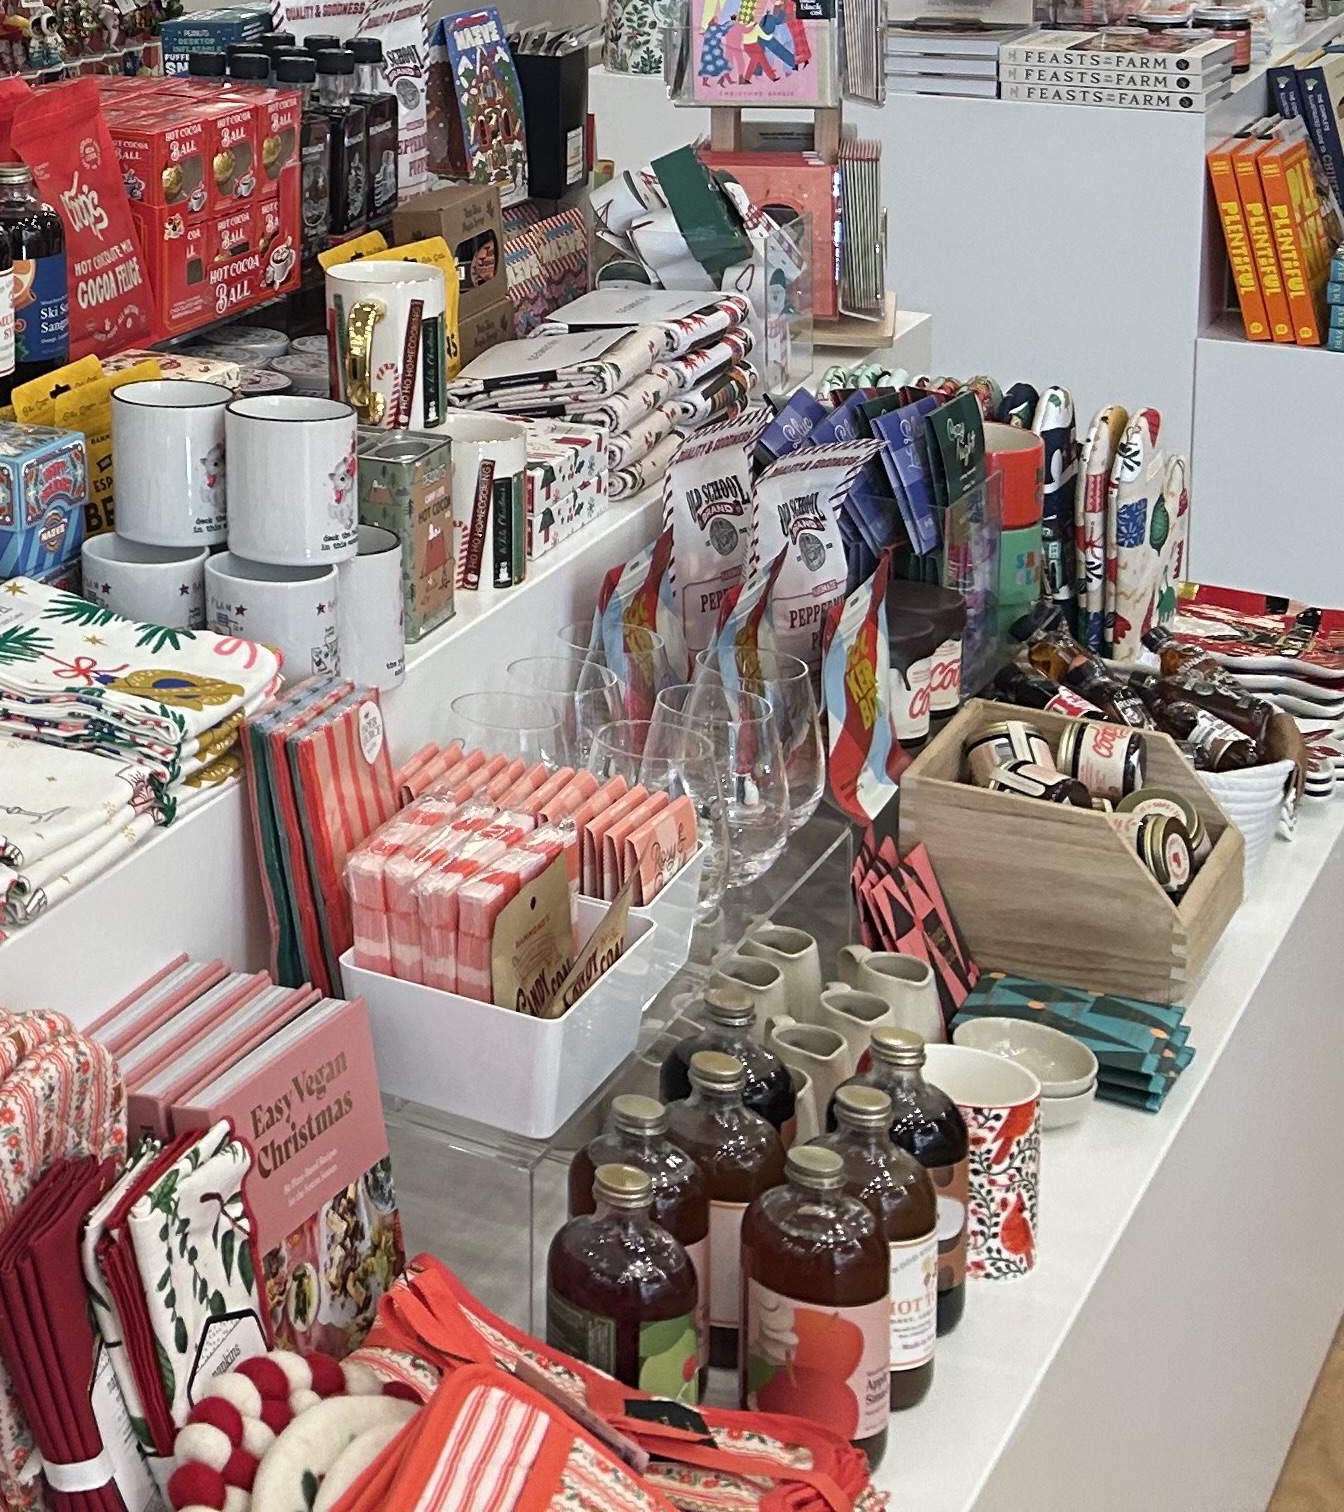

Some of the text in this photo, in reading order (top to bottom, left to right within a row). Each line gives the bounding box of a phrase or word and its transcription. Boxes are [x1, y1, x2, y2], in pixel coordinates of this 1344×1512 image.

[323, 2, 366, 18] GOODNESS
[1024, 51, 1168, 71] FEASTS FARM
[1024, 69, 1168, 89] FEASTS FARM
[1026, 87, 1171, 107] FEASTS FARM
[217, 111, 251, 129] HOT COCOA
[271, 112, 292, 132] BALL
[165, 124, 201, 143] HOT COCOA
[220, 127, 246, 148] BALL
[170, 141, 196, 162] BALL
[217, 212, 250, 232] HOT COCOA
[221, 228, 244, 250] BALL
[1221, 201, 1256, 296] PLENTIFUL
[1246, 202, 1282, 297] PLENTIFUL
[1271, 204, 1306, 300] PLENTIFUL
[209, 255, 259, 285] HOT COCOA
[76, 269, 115, 309] COCOA
[215, 279, 251, 315] BALL
[40, 306, 57, 320] Ski
[702, 475, 750, 506] SCHOOL
[250, 1051, 348, 1140] Easy Vegan
[256, 1090, 353, 1179] Christmas
